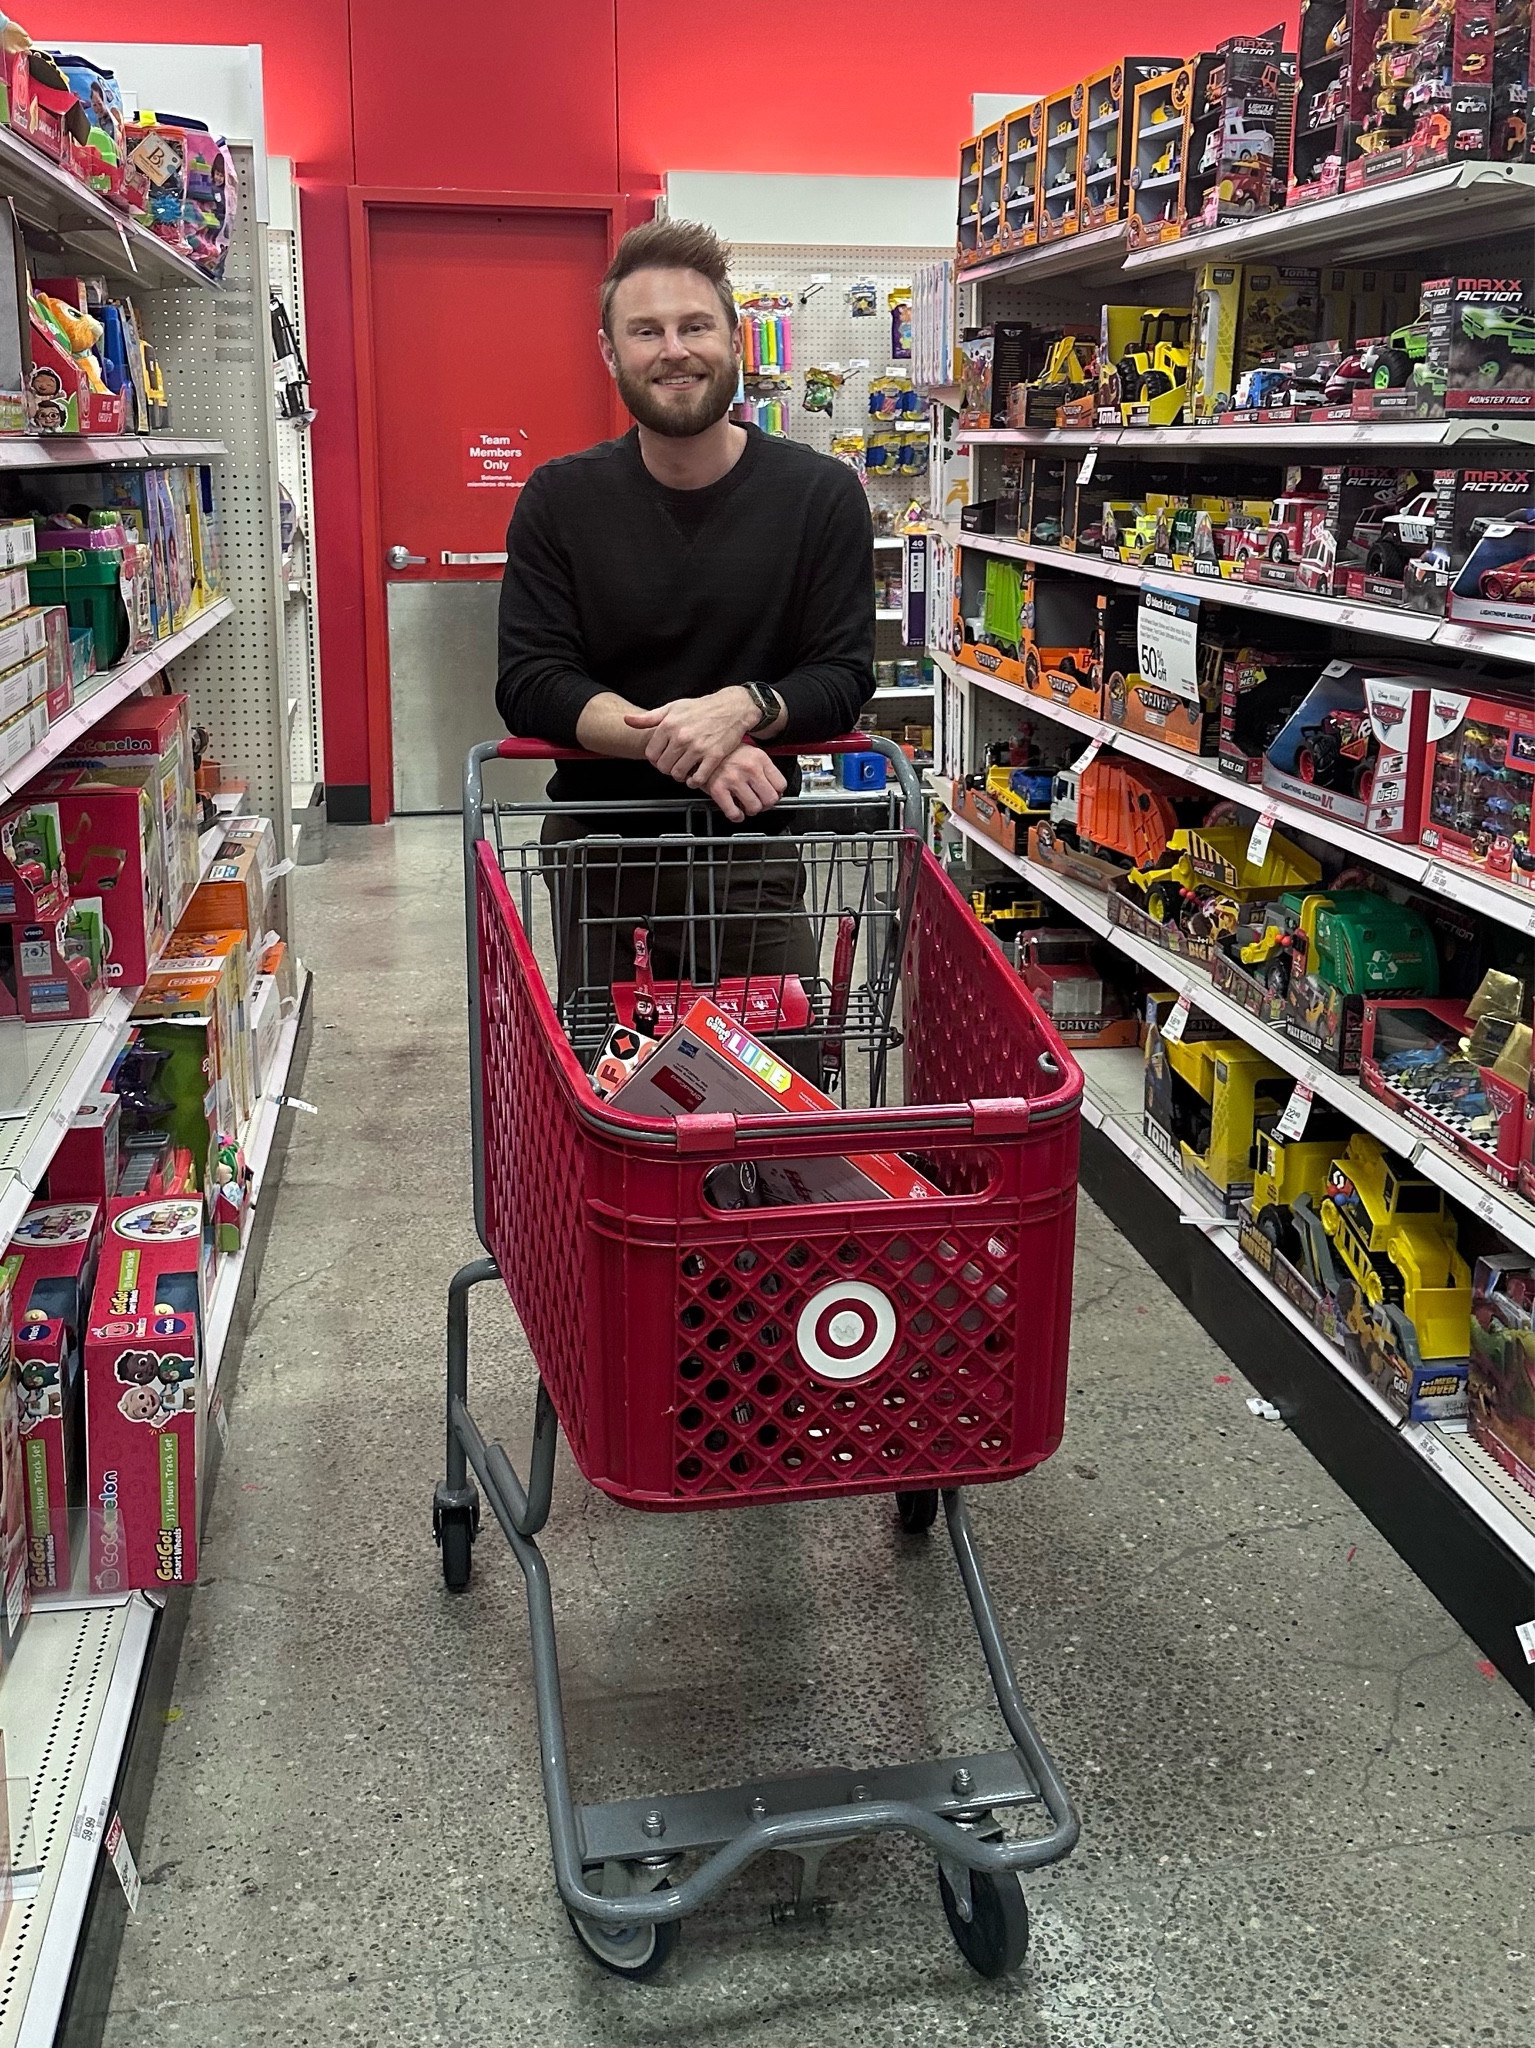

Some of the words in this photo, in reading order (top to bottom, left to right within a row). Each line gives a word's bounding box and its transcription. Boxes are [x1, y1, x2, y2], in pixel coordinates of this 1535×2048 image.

[1232, 46, 1274, 55] ACTION
[1234, 40, 1274, 49] MAXX
[1220, 217, 1238, 225] FOOD
[1281, 268, 1318, 278] Tonka
[1423, 280, 1450, 290] MAXX
[1457, 278, 1522, 291] MAXX
[1422, 288, 1450, 298] ACTION
[1455, 291, 1523, 302] ACTION
[1468, 396, 1504, 404] MONSTER
[1505, 396, 1531, 404] TRUCK
[1097, 407, 1121, 425] Tonka
[480, 435, 510, 445] Team
[469, 447, 522, 457] Members
[483, 460, 509, 471] Only
[1433, 470, 1455, 478] MAXX
[1464, 470, 1529, 483] MAXX
[1461, 483, 1529, 492] ACTION
[1176, 522, 1192, 532] Tonka
[1400, 524, 1428, 539] POLICE
[1101, 546, 1119, 559] Tonka
[1154, 553, 1173, 567] Tonka
[1195, 560, 1219, 575] Tonka
[1151, 597, 1163, 608] black
[1163, 600, 1177, 615] friday
[1480, 609, 1506, 617] LIGHTNING
[1507, 612, 1531, 620] McQUEEN
[979, 654, 998, 669] DRIVEN
[1142, 644, 1157, 678] 50
[1157, 649, 1164, 667] %
[1158, 668, 1167, 681] off
[1240, 670, 1253, 678] TRY
[1051, 676, 1073, 692] DRIVEN
[1240, 677, 1254, 686] ME!
[1143, 691, 1171, 711] DRIVEN
[1220, 759, 1234, 770] POLICE
[1235, 762, 1244, 773] CAR
[1376, 789, 1399, 802] USB
[1194, 868, 1215, 878] ACTION
[1434, 917, 1474, 941] ACTION
[706, 1017, 730, 1036] Game
[714, 1016, 726, 1028] the
[1060, 1021, 1100, 1030] DRIVEN
[727, 1033, 788, 1089] LIFE
[601, 1065, 619, 1083] F
[671, 1074, 698, 1097] RedCard
[1145, 1110, 1182, 1170] Tonka
[1393, 1376, 1408, 1395] GO!
[1434, 1377, 1458, 1385] MEGA
[1419, 1385, 1456, 1396] MOVER
[32, 1444, 40, 1457] Set
[164, 1438, 173, 1451] Set
[33, 1459, 42, 1485] Track
[165, 1454, 173, 1478] Track
[166, 1480, 175, 1503] House
[36, 1487, 45, 1512] House
[173, 1528, 182, 1554] Wheels
[155, 1530, 173, 1581] Go!Go!
[173, 1555, 182, 1580] Smart
[82, 1816, 97, 1841] 59.99
